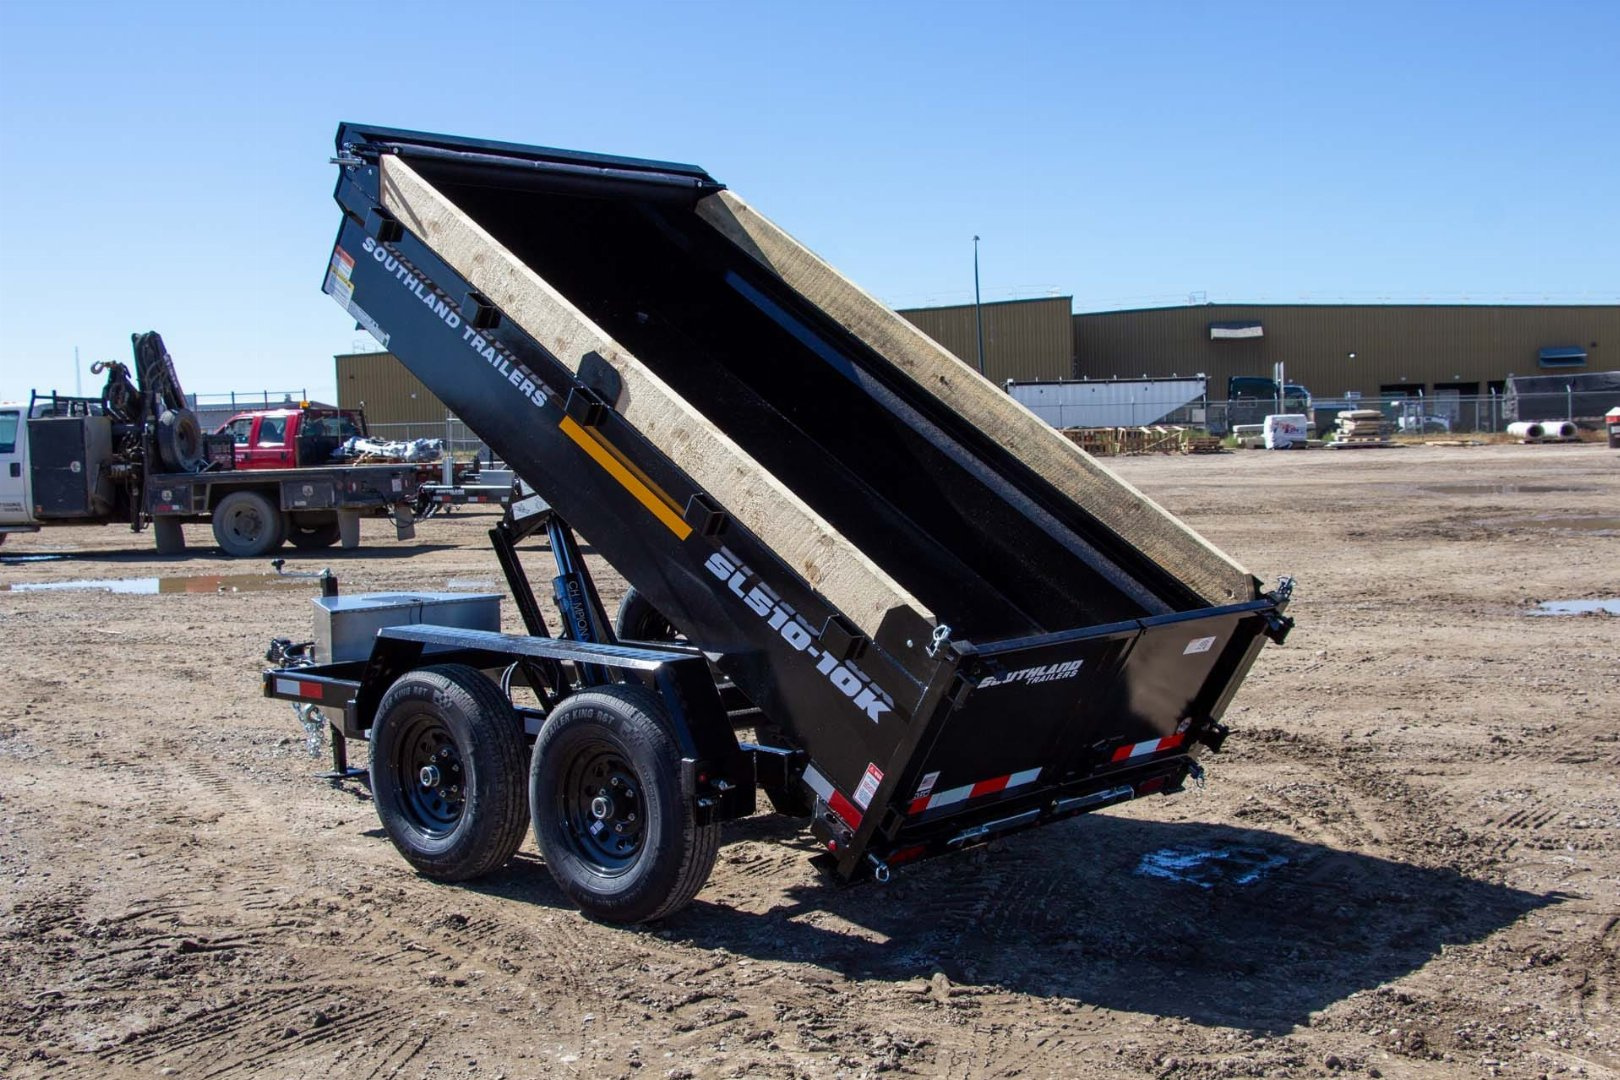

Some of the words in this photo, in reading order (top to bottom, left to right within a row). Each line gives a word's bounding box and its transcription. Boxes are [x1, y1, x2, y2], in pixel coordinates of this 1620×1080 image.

[363, 237, 460, 328] SOUTHLAND
[463, 325, 548, 408] TRAILERS
[568, 581, 589, 638] CHMPION
[704, 552, 892, 724] SL510-10K
[1026, 669, 1079, 685] TRAILERS
[572, 708, 594, 720] KING
